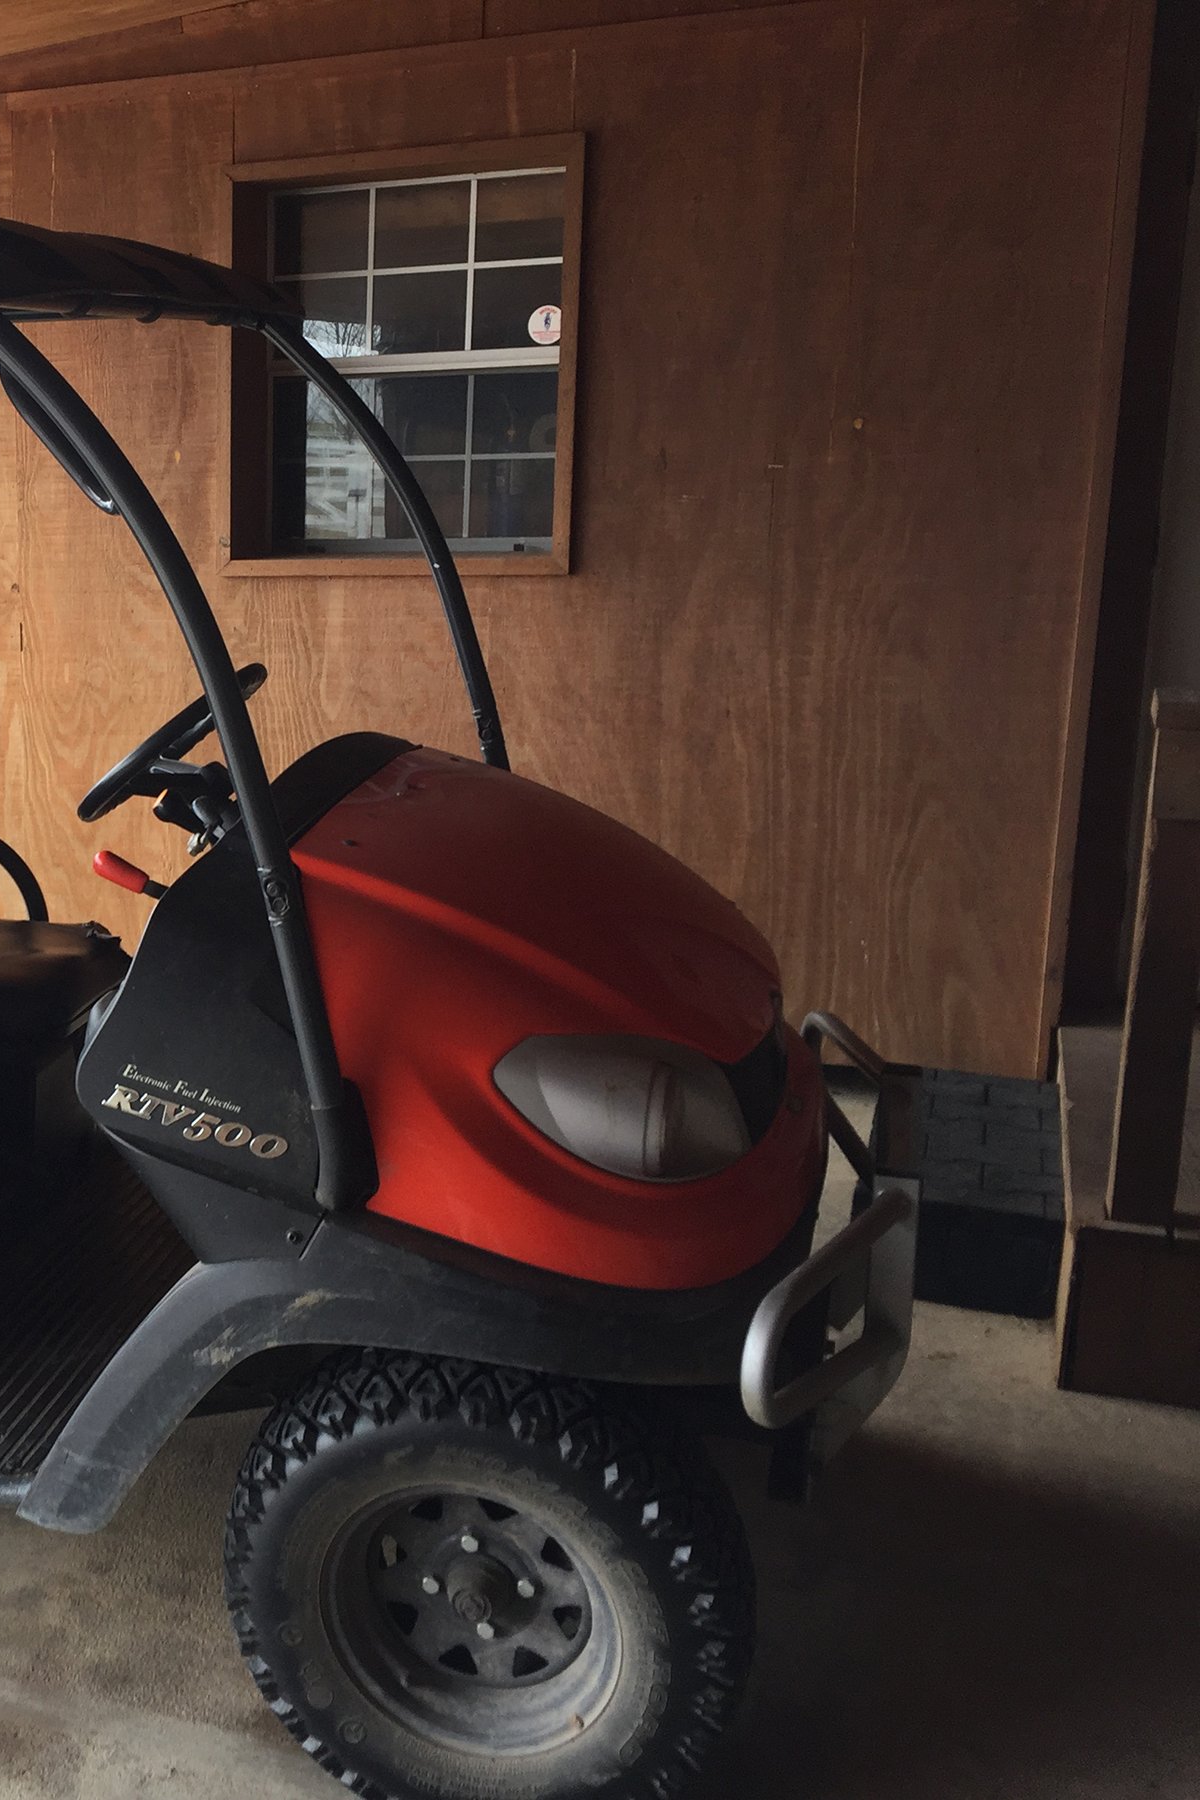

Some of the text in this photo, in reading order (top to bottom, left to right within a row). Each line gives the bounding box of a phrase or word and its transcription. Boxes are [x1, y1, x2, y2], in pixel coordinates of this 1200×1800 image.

[122, 1063, 242, 1114] Electronic Fuel Injection
